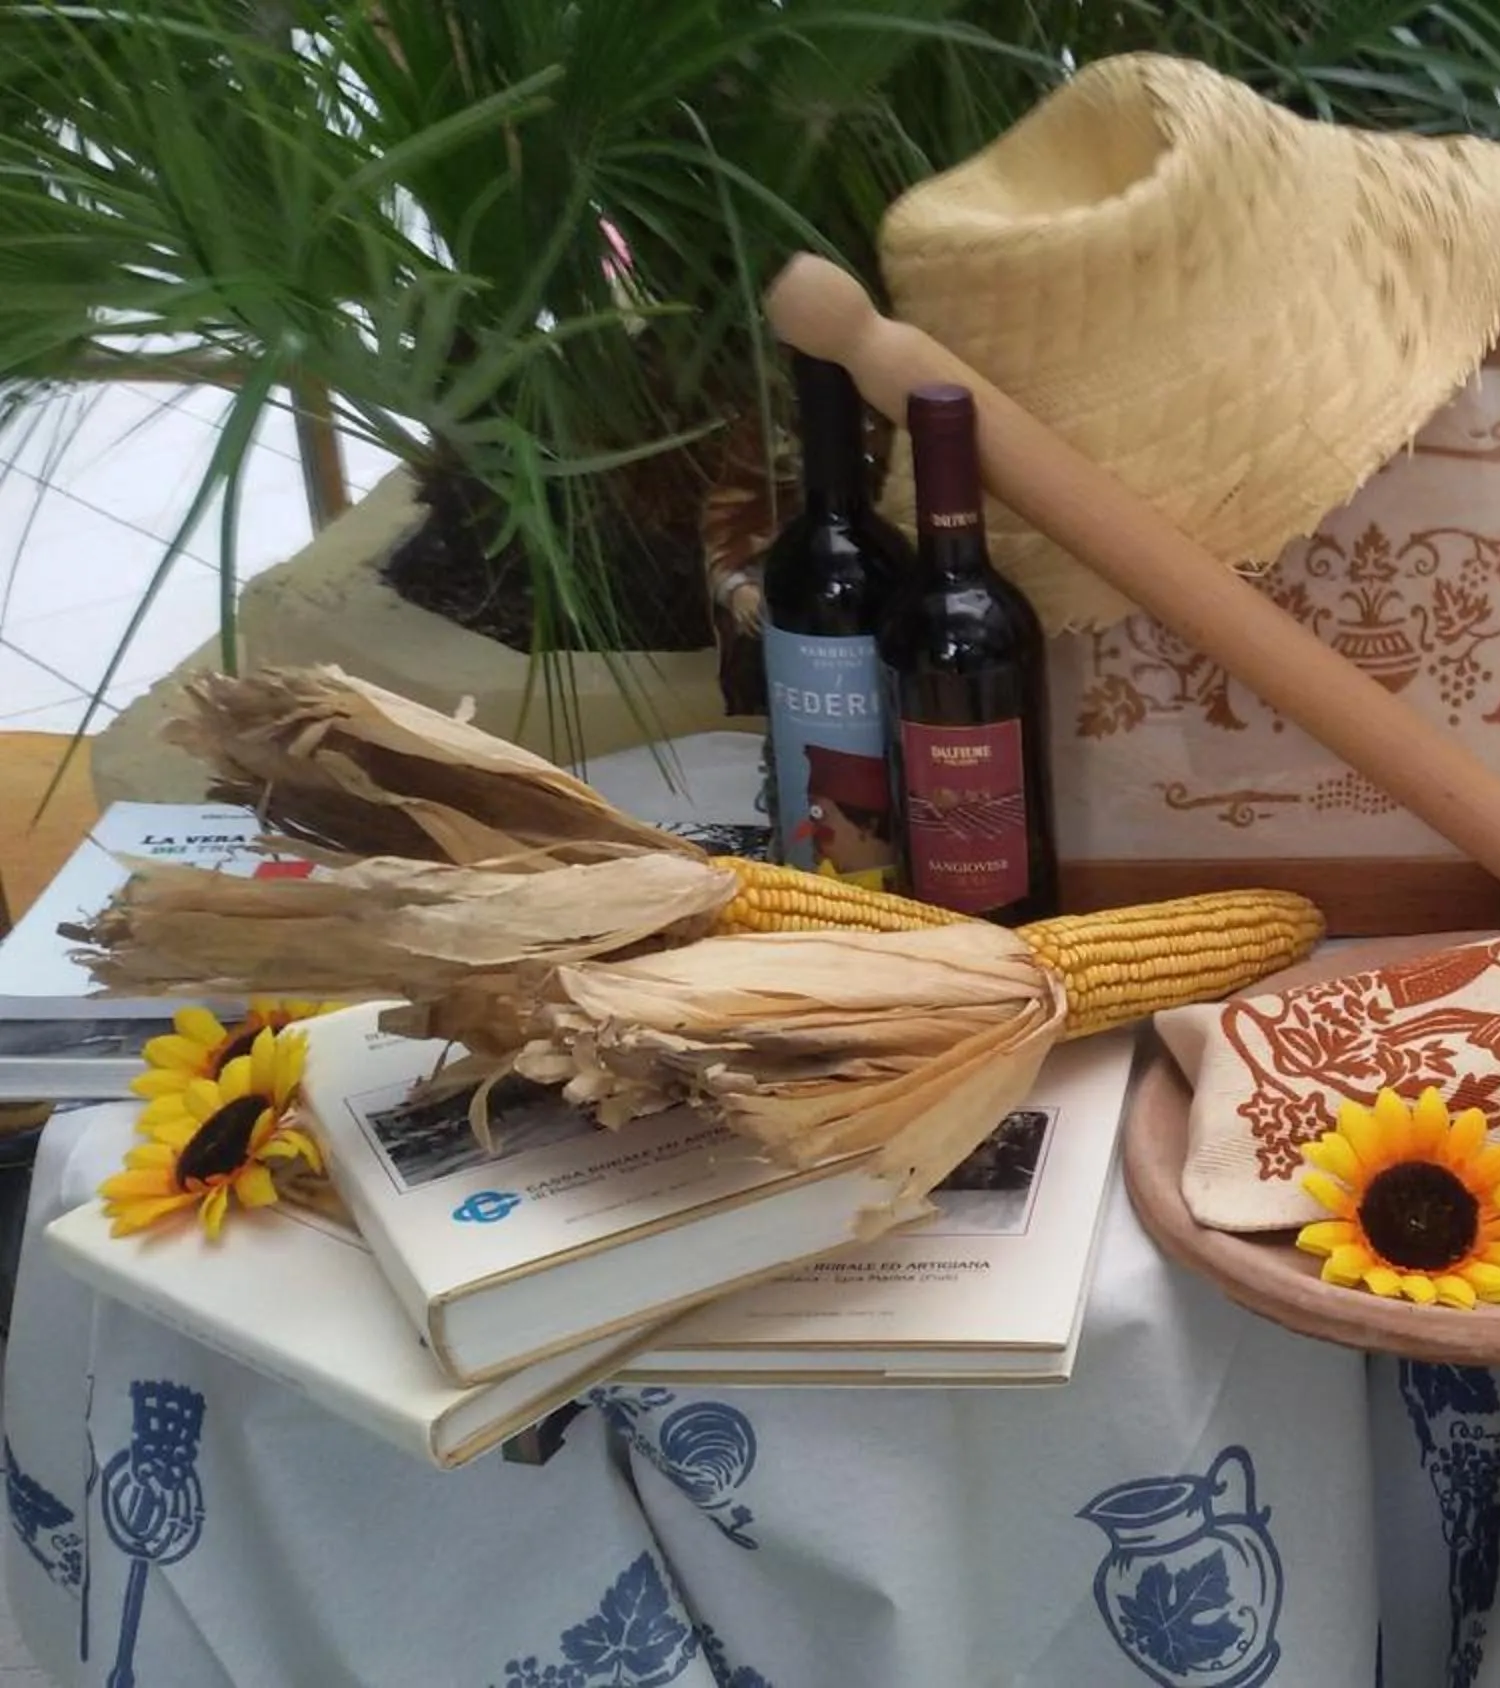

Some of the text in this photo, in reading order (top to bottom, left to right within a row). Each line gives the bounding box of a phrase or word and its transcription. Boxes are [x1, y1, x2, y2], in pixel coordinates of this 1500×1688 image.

[140, 835, 246, 844] LA VERA
[928, 859, 1009, 873] SANGIOVESE
[813, 1260, 992, 1273] RURALE ED ARTIGIANA
